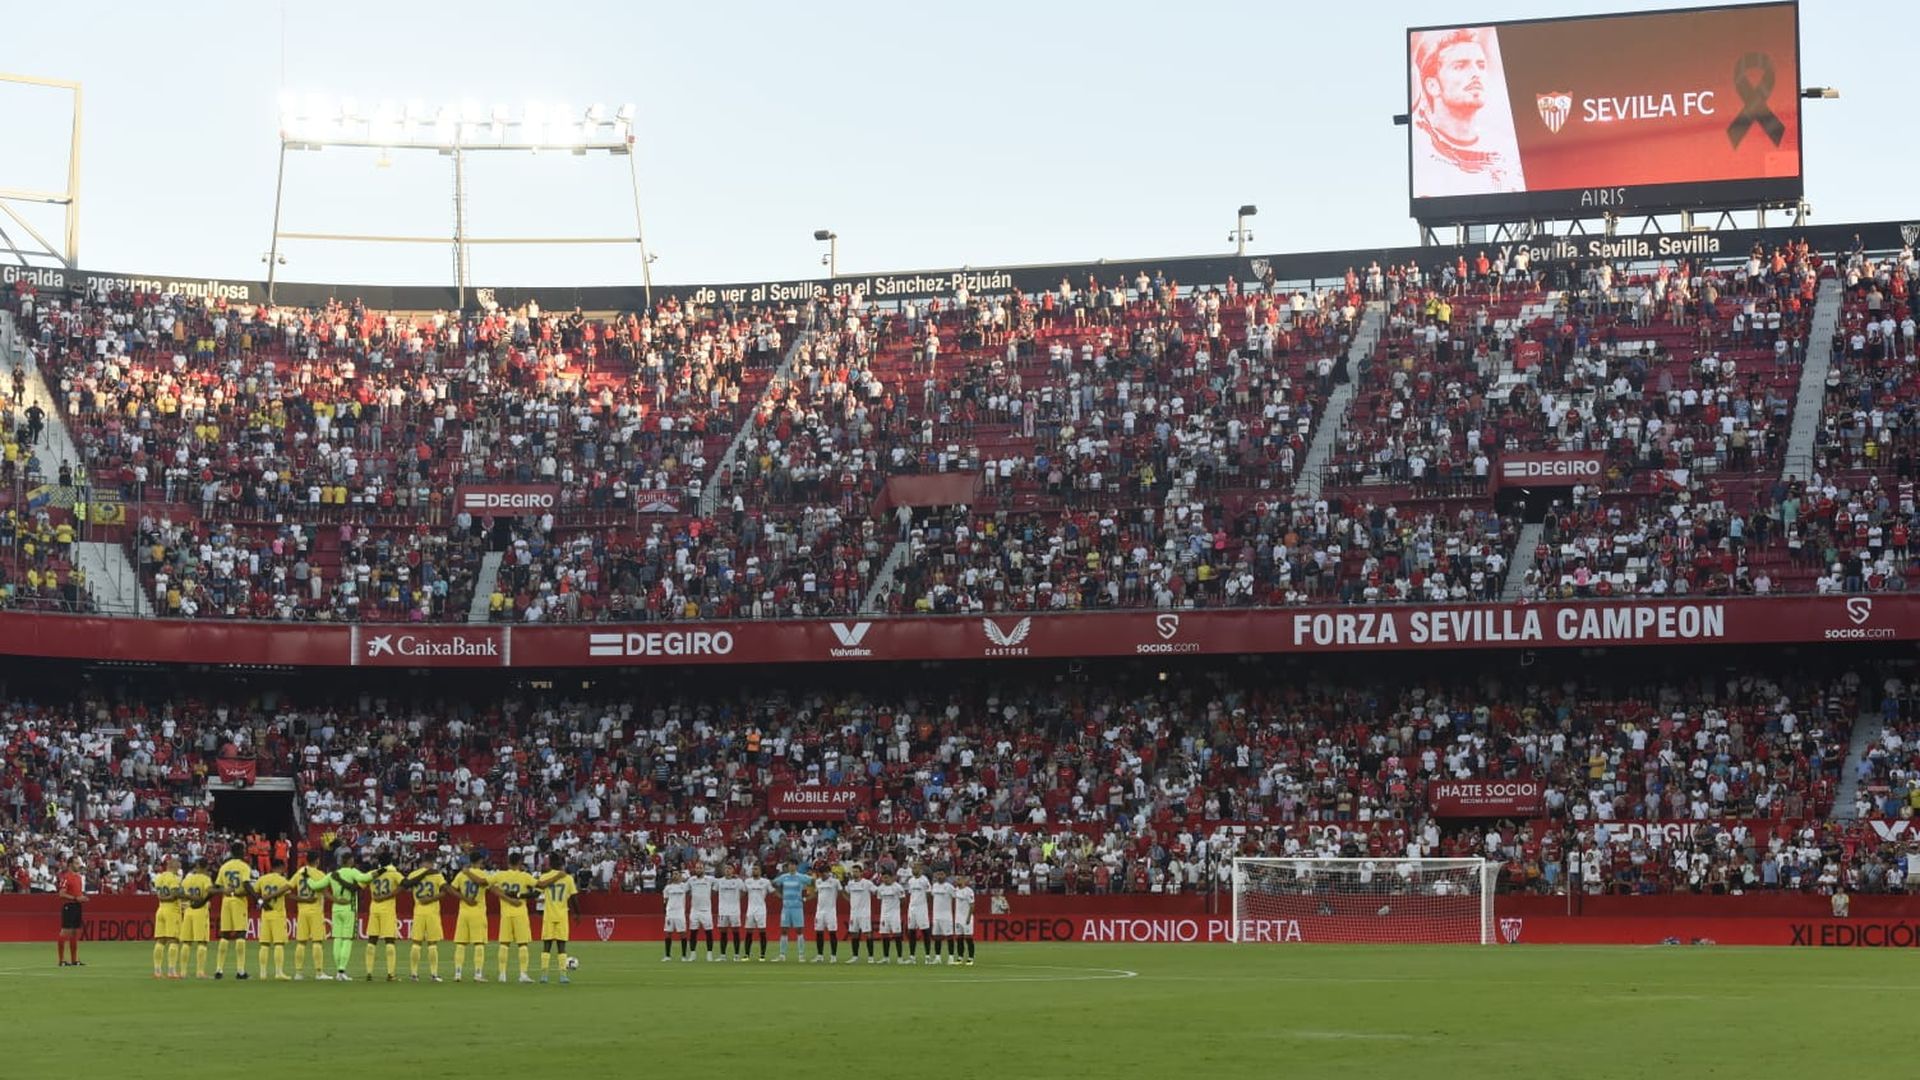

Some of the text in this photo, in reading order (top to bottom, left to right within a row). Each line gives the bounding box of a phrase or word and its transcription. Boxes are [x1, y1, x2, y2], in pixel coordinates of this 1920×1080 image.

[1583, 92, 1715, 122] SEVILLA FC
[1581, 188, 1626, 207] AIRIS
[1501, 245, 1513, 265] Y
[1659, 235, 1720, 255] Sevilla
[3, 266, 64, 288] Giralda
[696, 287, 716, 304] de
[720, 288, 747, 303] ver
[751, 284, 766, 302] al
[833, 282, 852, 297] en
[875, 270, 1012, 294] Sánchez-Pizjuán
[1528, 460, 1600, 476] DEGIRO
[487, 493, 554, 508] DEGIRO
[1294, 605, 1724, 646] FORZA SEVILLA CAMPEON
[398, 635, 499, 656] CaixaBank
[626, 631, 734, 656] DEGIRO
[830, 648, 871, 657] Valvoline
[783, 791, 856, 802] MOBILE APP
[1437, 783, 1537, 800] ¡HAZTE SOCIO!
[373, 879, 391, 897] 33
[416, 881, 434, 898] 23
[550, 884, 566, 901] 17
[1082, 919, 1198, 941] ANTONIO
[1208, 919, 1302, 941] PUERTA
[1790, 920, 1920, 947] XI EDICIÓ
